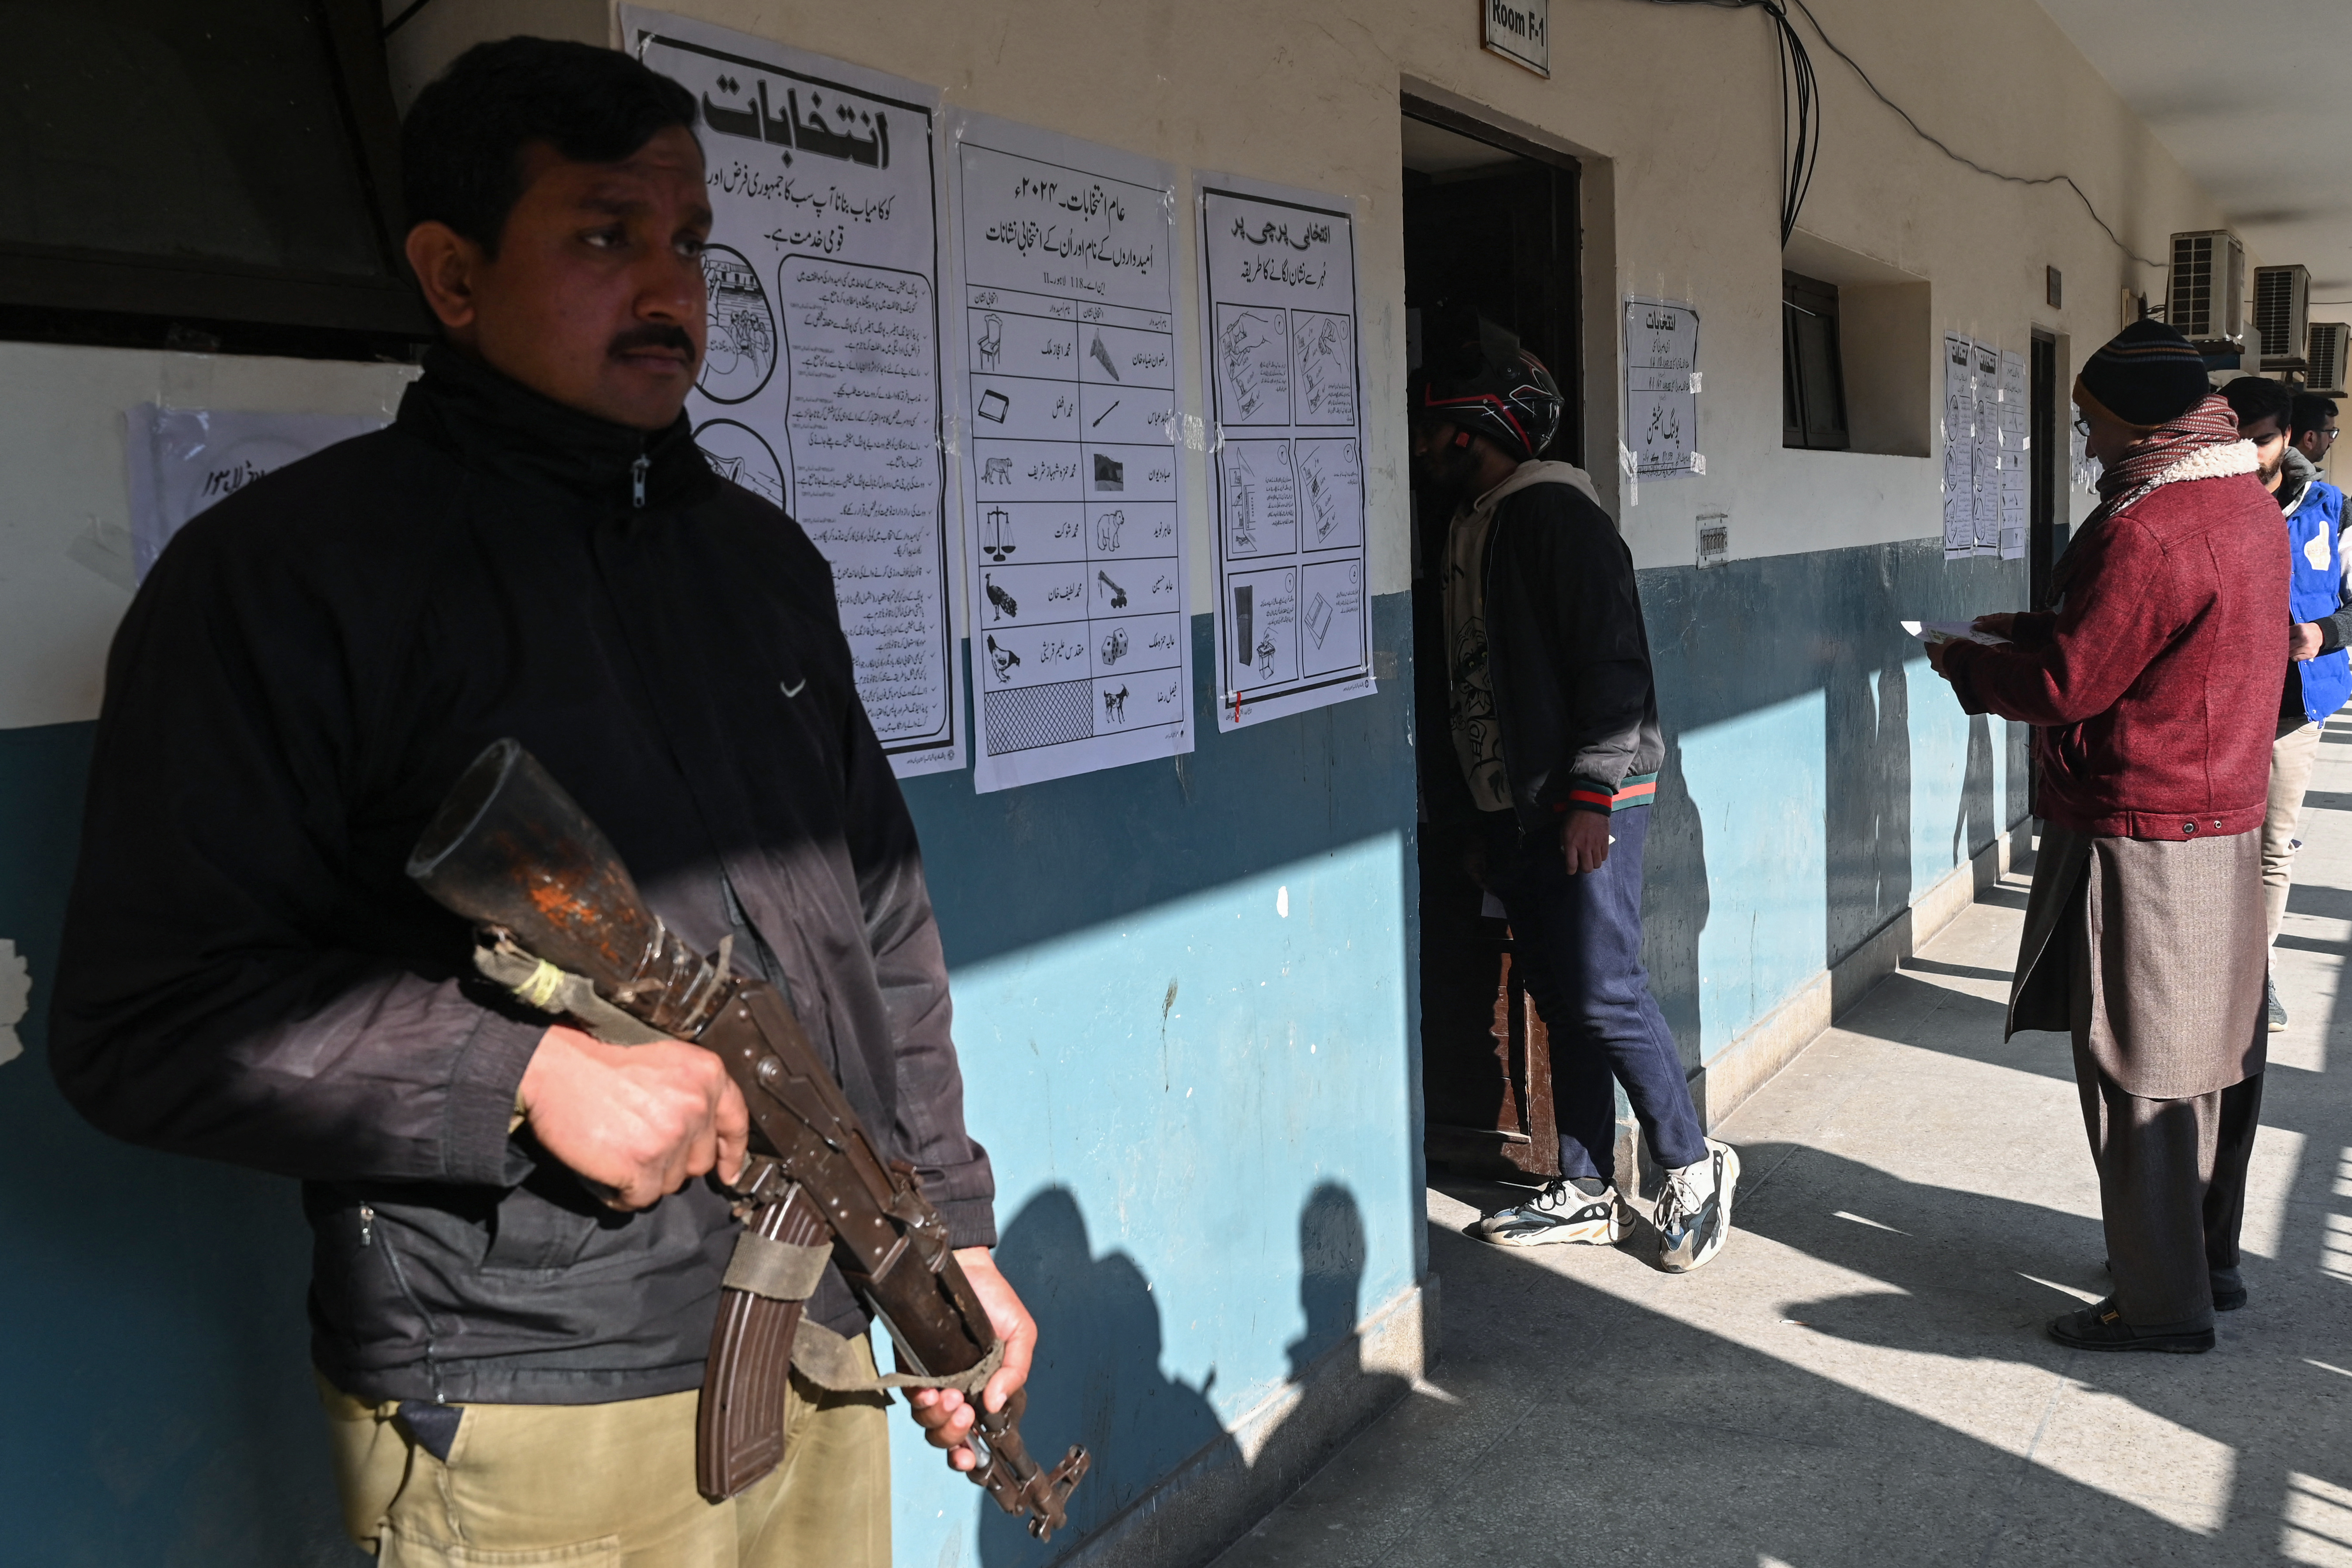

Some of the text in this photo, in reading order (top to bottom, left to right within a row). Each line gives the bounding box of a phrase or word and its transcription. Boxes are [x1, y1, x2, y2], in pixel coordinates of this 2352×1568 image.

[1492, 0, 1544, 47] Room F-1
[702, 74, 889, 170] انتخابات
[707, 168, 723, 185] اور
[724, 161, 747, 194] فرض
[747, 172, 783, 200] جمہوری
[785, 178, 795, 200] کا
[791, 193, 813, 208] سب
[813, 186, 836, 217] آپ
[835, 192, 849, 214] بنانا
[851, 198, 886, 223] کامیاب
[1108, 196, 1125, 233] عام
[790, 230, 823, 247] خدمت
[824, 225, 844, 253] قومی
[986, 221, 1017, 244] نشانات
[1017, 221, 1042, 257] انتخابی
[1044, 225, 1059, 252] کے
[1231, 216, 1330, 251] انتخابی پرچی پر
[1074, 239, 1084, 257] اور
[1086, 239, 1097, 270] نام
[1098, 235, 1112, 261] کے
[1241, 254, 1263, 283] طریقہ
[1263, 258, 1271, 280] کا
[1269, 258, 1288, 282] لگانے
[1289, 262, 1305, 286] نشان
[1305, 273, 1317, 285] سے
[1097, 282, 1105, 296] این
[974, 292, 998, 308] انتخابی نشان
[1083, 307, 1104, 322] انتخابی نشان
[1646, 310, 1675, 335] انتخابات
[1041, 338, 1052, 355] ملک
[1053, 344, 1063, 360] اعجاز
[1132, 353, 1143, 366] خان
[1151, 353, 1168, 368] رضوان
[1052, 396, 1066, 419] افضل
[1148, 411, 1161, 426] عباس
[1647, 402, 1680, 450] پولنگ اسٹیشن
[1028, 461, 1046, 481] شریف
[1046, 463, 1059, 481] شہباز
[1060, 466, 1069, 481] حمزہ
[1055, 522, 1071, 538] شوکت
[1154, 522, 1171, 538] طاہر نوید
[1048, 587, 1060, 602] خان
[1060, 582, 1075, 601] لطیف
[1152, 575, 1173, 594] عابد حسین
[1149, 632, 1158, 648] ملک
[1158, 692, 1167, 703] رضا
